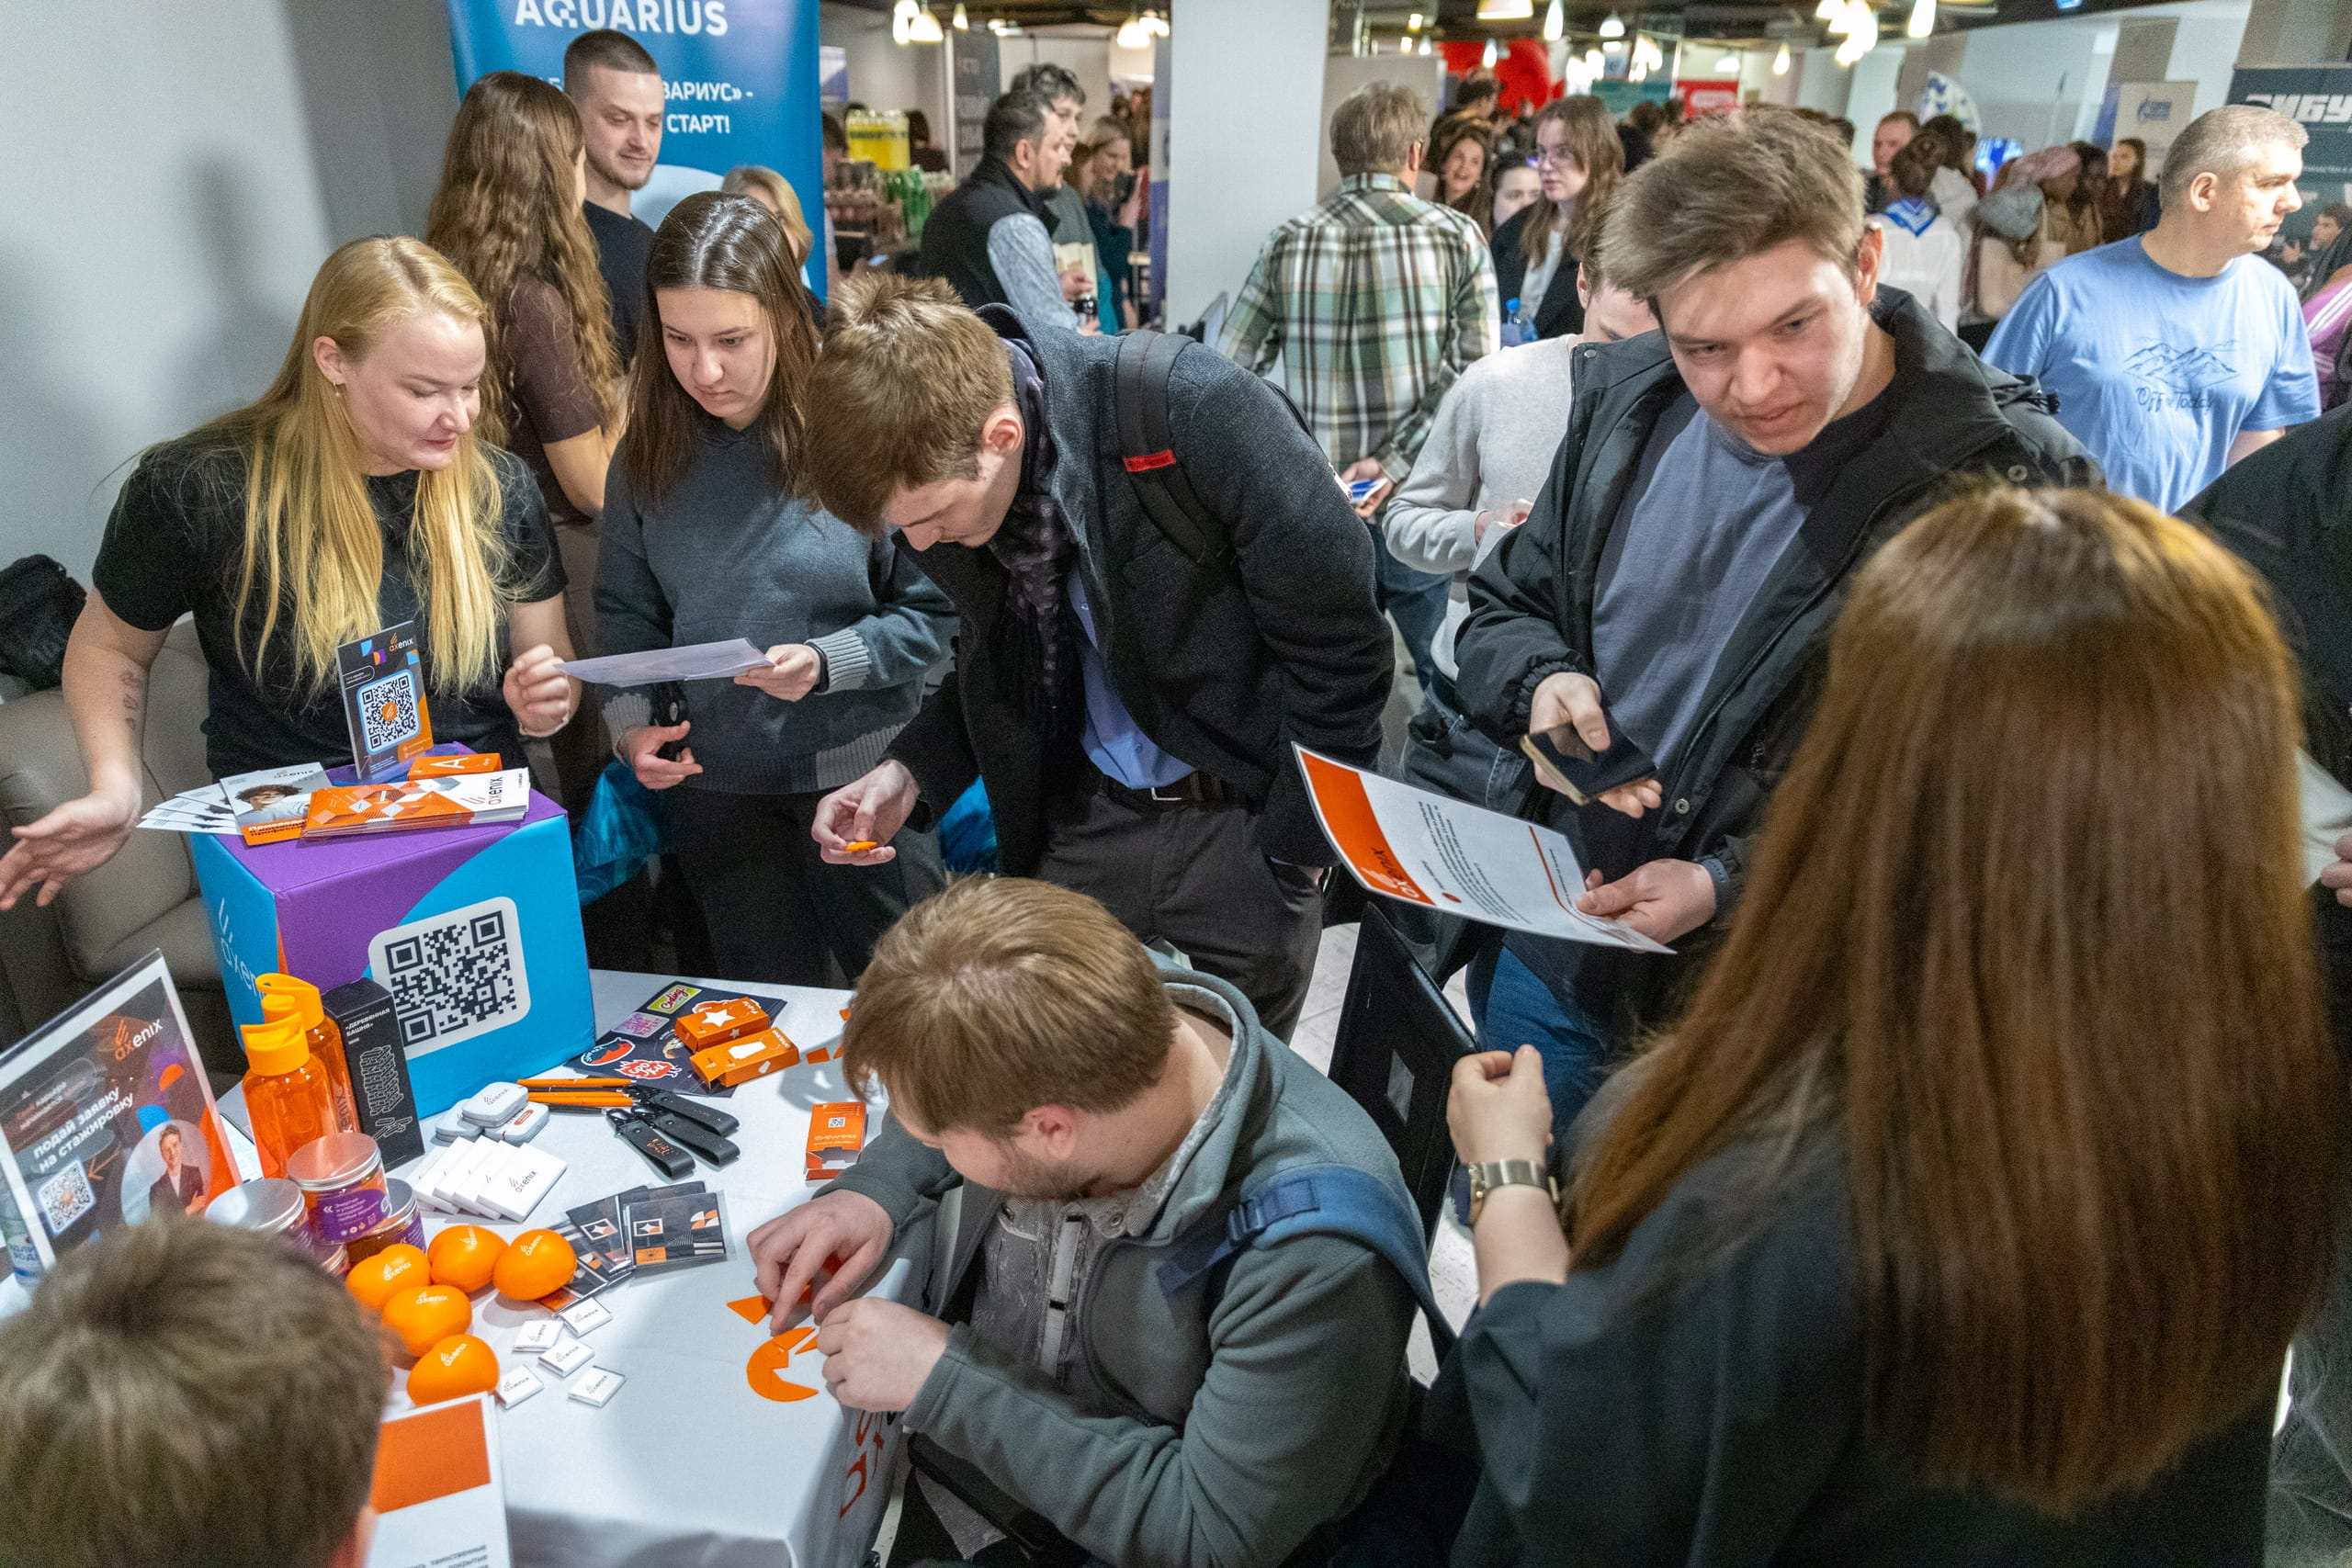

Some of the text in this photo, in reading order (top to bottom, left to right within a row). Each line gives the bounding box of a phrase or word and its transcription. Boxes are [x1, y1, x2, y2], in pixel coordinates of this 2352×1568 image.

[514, 0, 729, 37] AQUARIUS
[666, 113, 731, 134] СТАРТ!
[661, 987, 689, 1010] Coding
[114, 1018, 164, 1062] axenix
[33, 1119, 76, 1158] подай
[77, 1087, 119, 1125] заявку
[39, 1155, 58, 1173] на
[58, 1092, 133, 1157] стажировку
[514, 1170, 537, 1193] axenix
[525, 1235, 544, 1257] axenix
[384, 1261, 412, 1281] axenix
[416, 1294, 448, 1305] axenix
[444, 1342, 468, 1367] axenix
